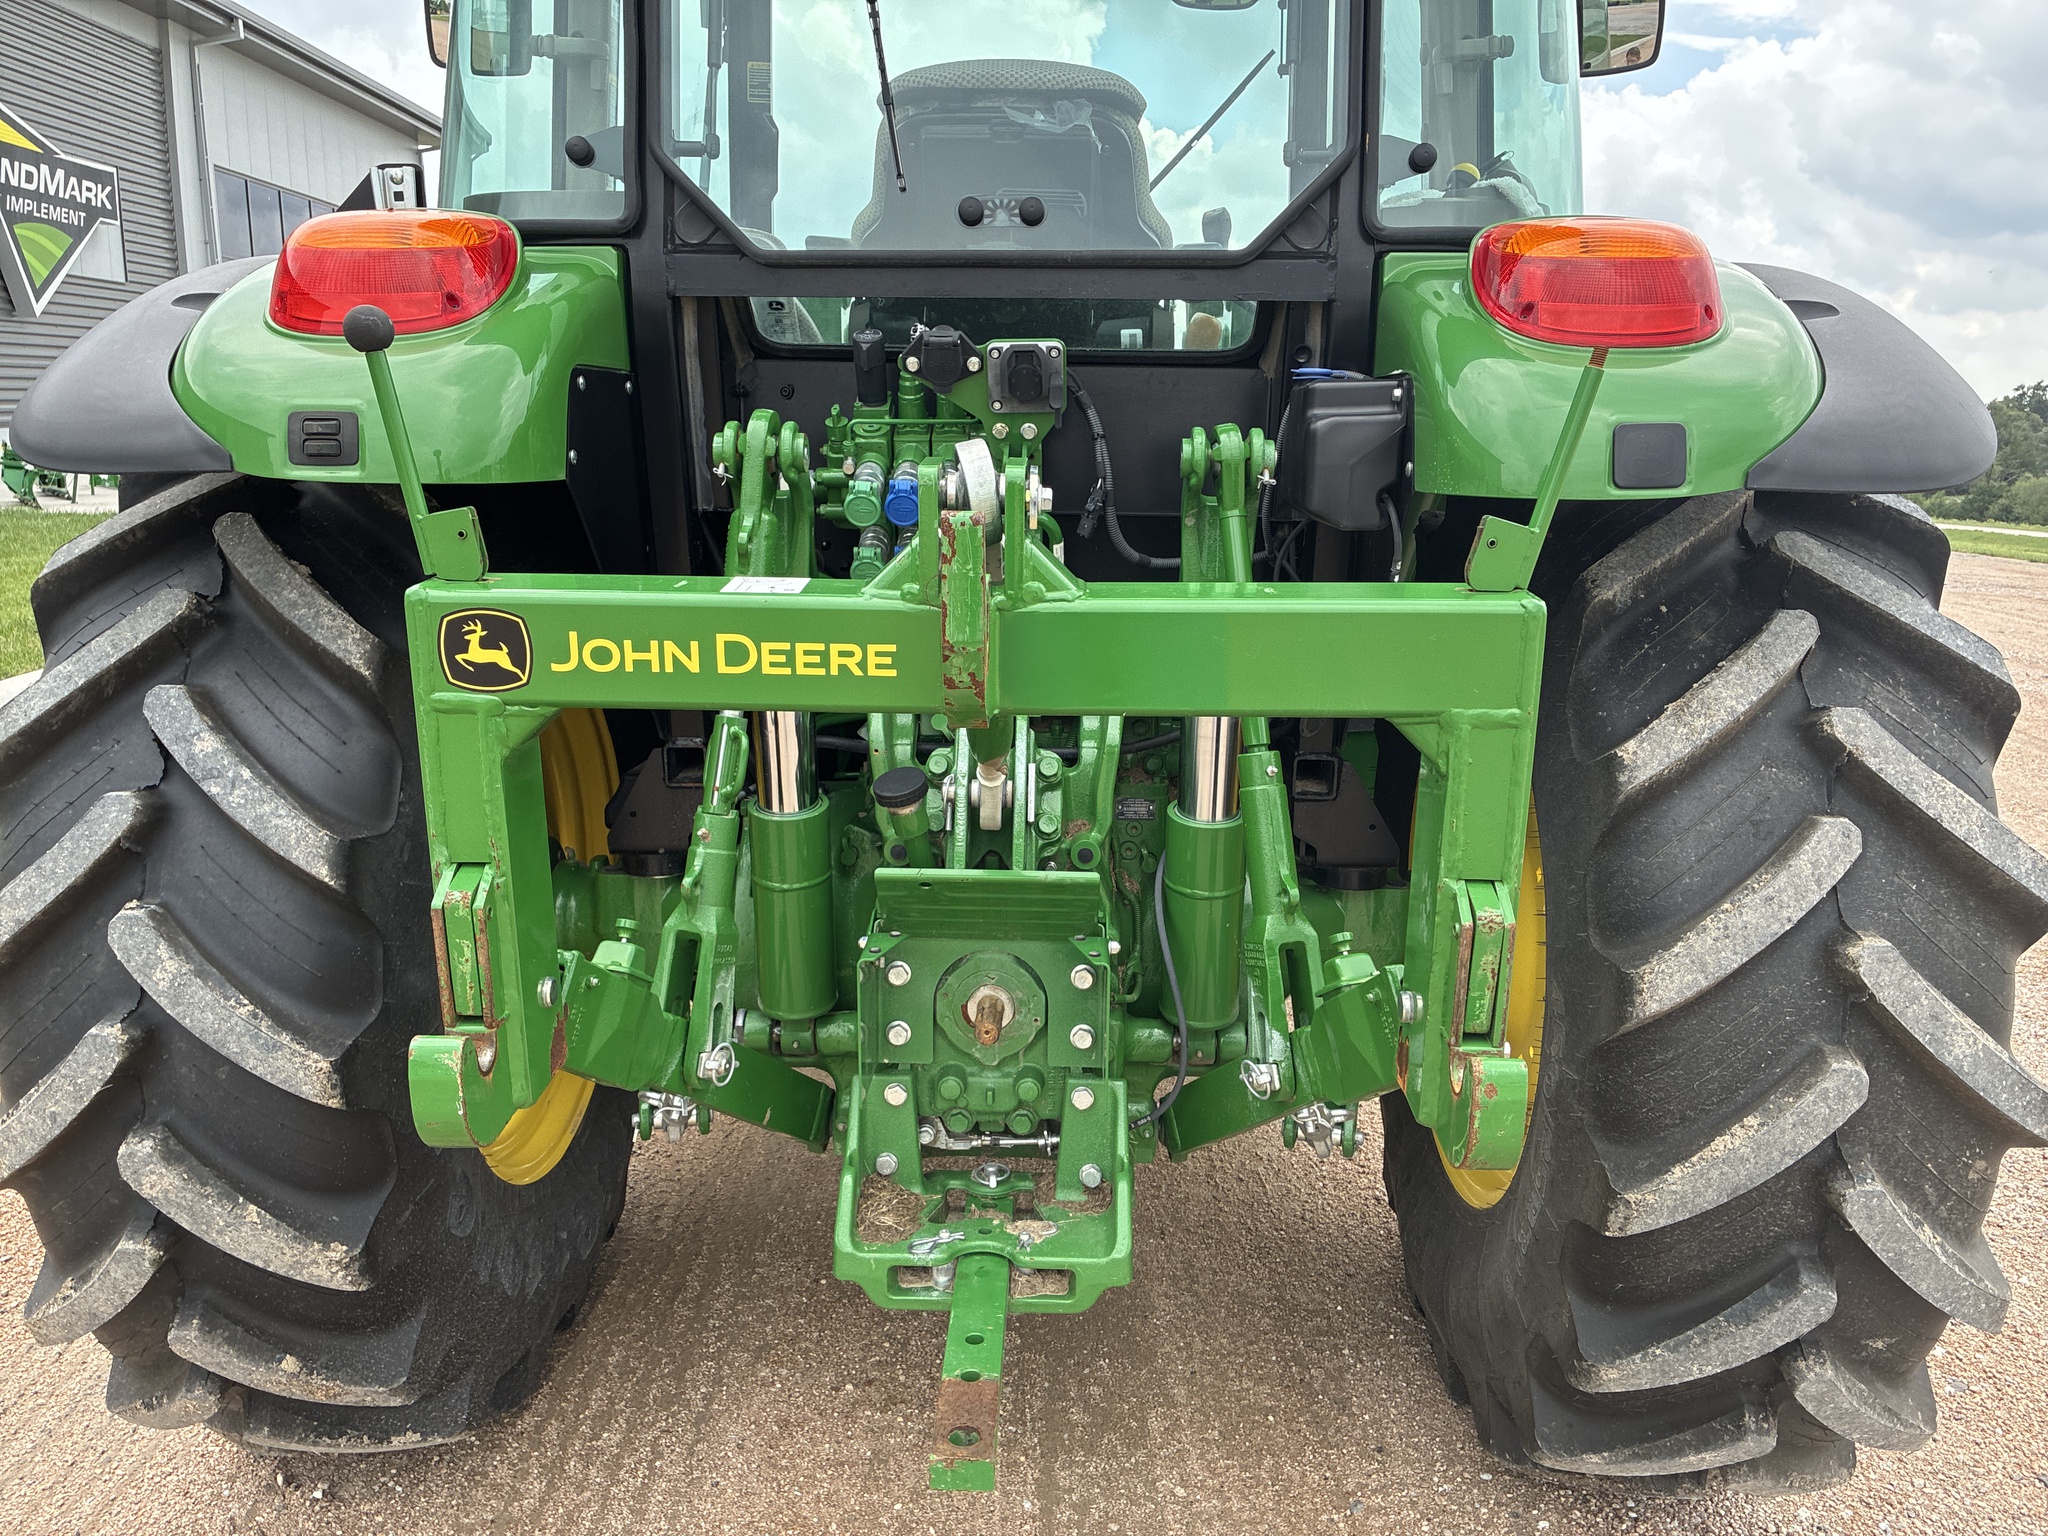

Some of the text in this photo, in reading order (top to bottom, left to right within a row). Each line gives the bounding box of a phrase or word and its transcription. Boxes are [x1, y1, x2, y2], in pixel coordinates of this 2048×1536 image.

[6, 194, 87, 227] IMPLEMENT
[550, 630, 898, 677] JOHN DEERE
